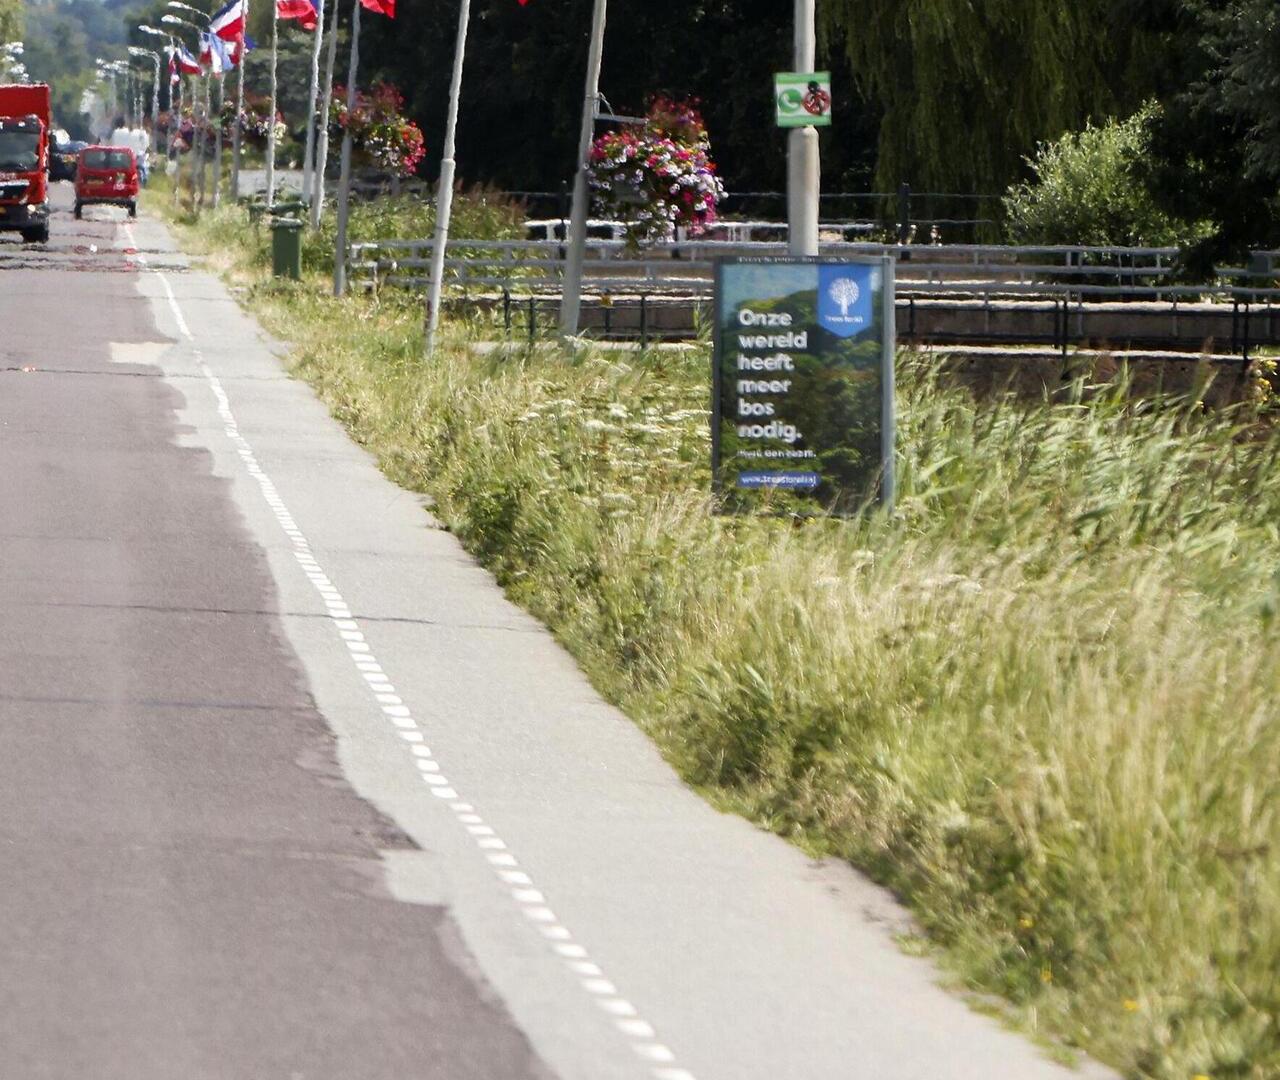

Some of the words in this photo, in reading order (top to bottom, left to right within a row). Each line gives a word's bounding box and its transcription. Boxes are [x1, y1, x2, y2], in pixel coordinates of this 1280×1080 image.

[738, 308, 792, 326] Onze
[738, 330, 808, 349] wereld
[737, 352, 795, 370] heeft
[737, 379, 792, 393] meer
[738, 398, 775, 416] bos
[738, 420, 803, 443] nodig.
